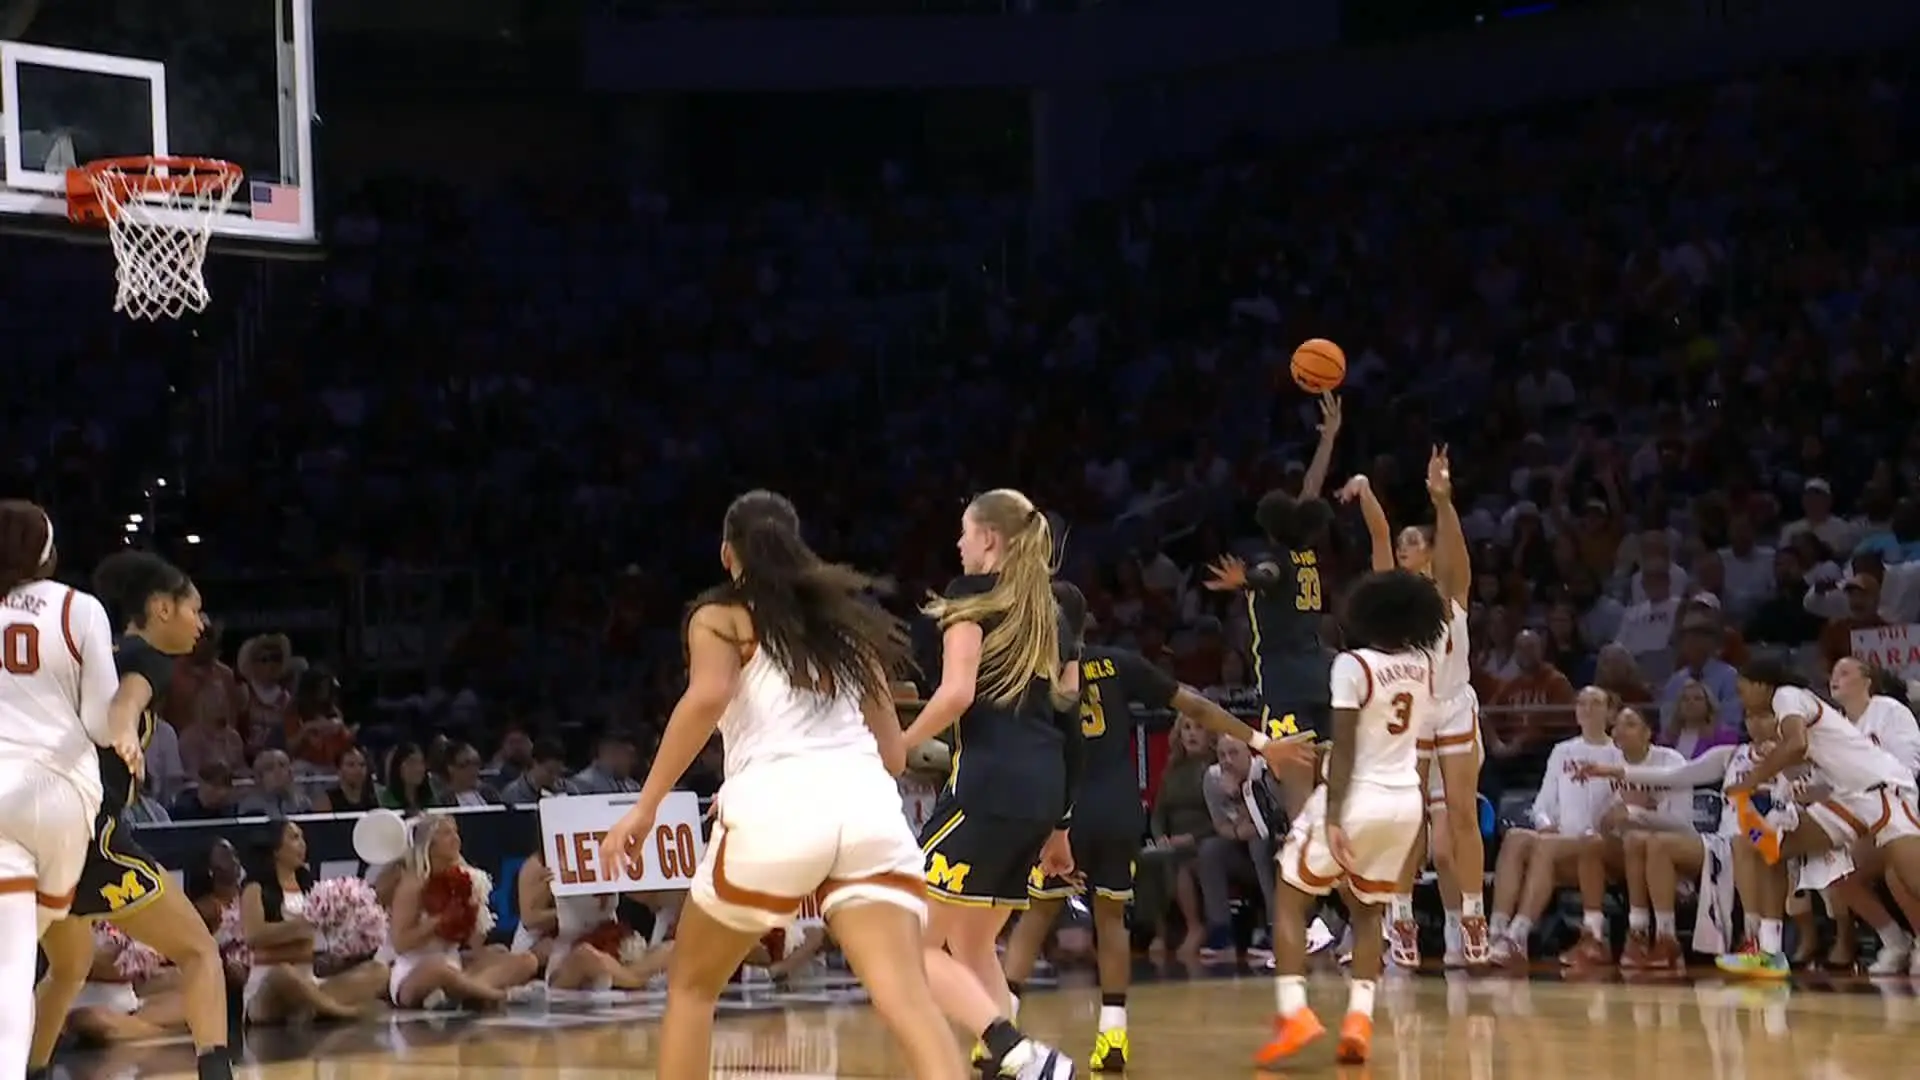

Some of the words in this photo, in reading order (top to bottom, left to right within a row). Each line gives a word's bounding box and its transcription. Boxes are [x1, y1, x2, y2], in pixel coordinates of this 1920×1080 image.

[1296, 567, 1322, 610] 33
[1268, 713, 1299, 738] M
[1387, 692, 1414, 735] 3
[656, 823, 697, 880] GO
[926, 851, 971, 895] M
[99, 869, 146, 910] M
